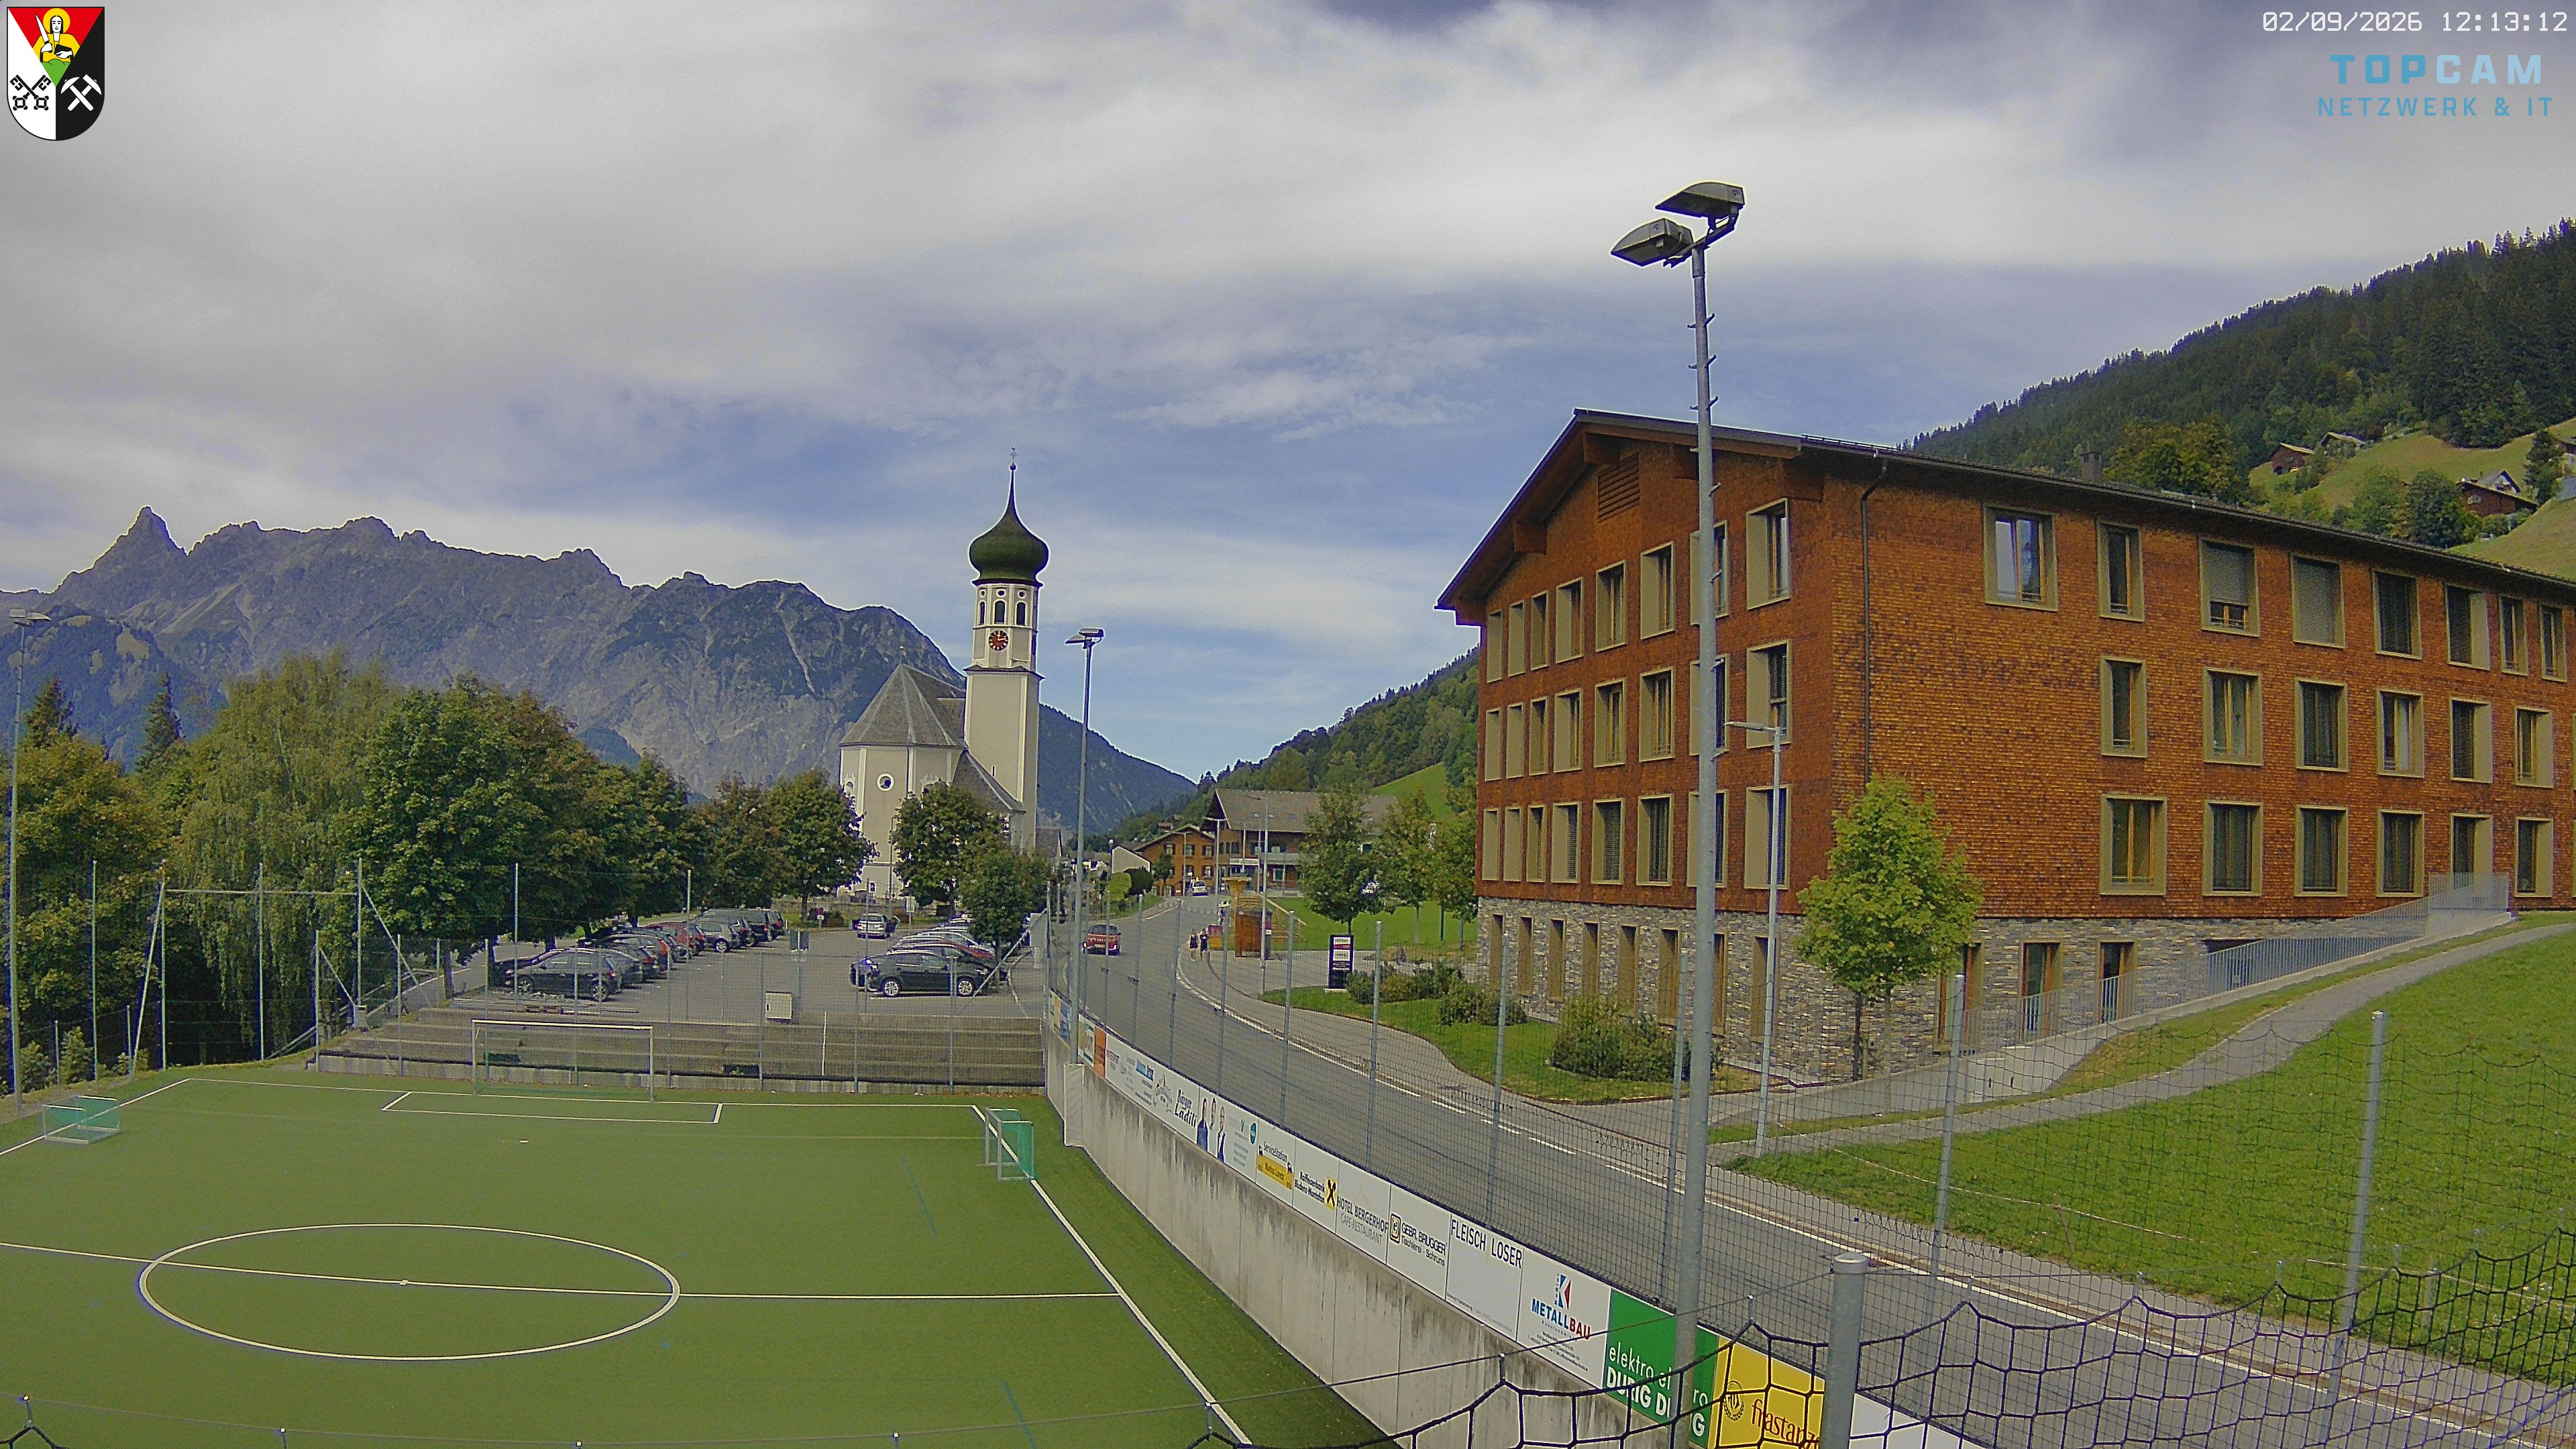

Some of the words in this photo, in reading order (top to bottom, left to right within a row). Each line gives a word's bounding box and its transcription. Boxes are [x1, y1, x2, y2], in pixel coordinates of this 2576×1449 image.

[1337, 1195, 1354, 1216] HOTEL
[1354, 1205, 1389, 1234] BERGERHOF
[1418, 1231, 1446, 1256] BRUGGER
[1451, 1219, 1487, 1252] FLEISCH
[1491, 1238, 1522, 1269] LOSER
[1532, 1298, 1591, 1340] METALLBAU
[1609, 1342, 1654, 1381] elektro
[1658, 1366, 1708, 1407] elro
